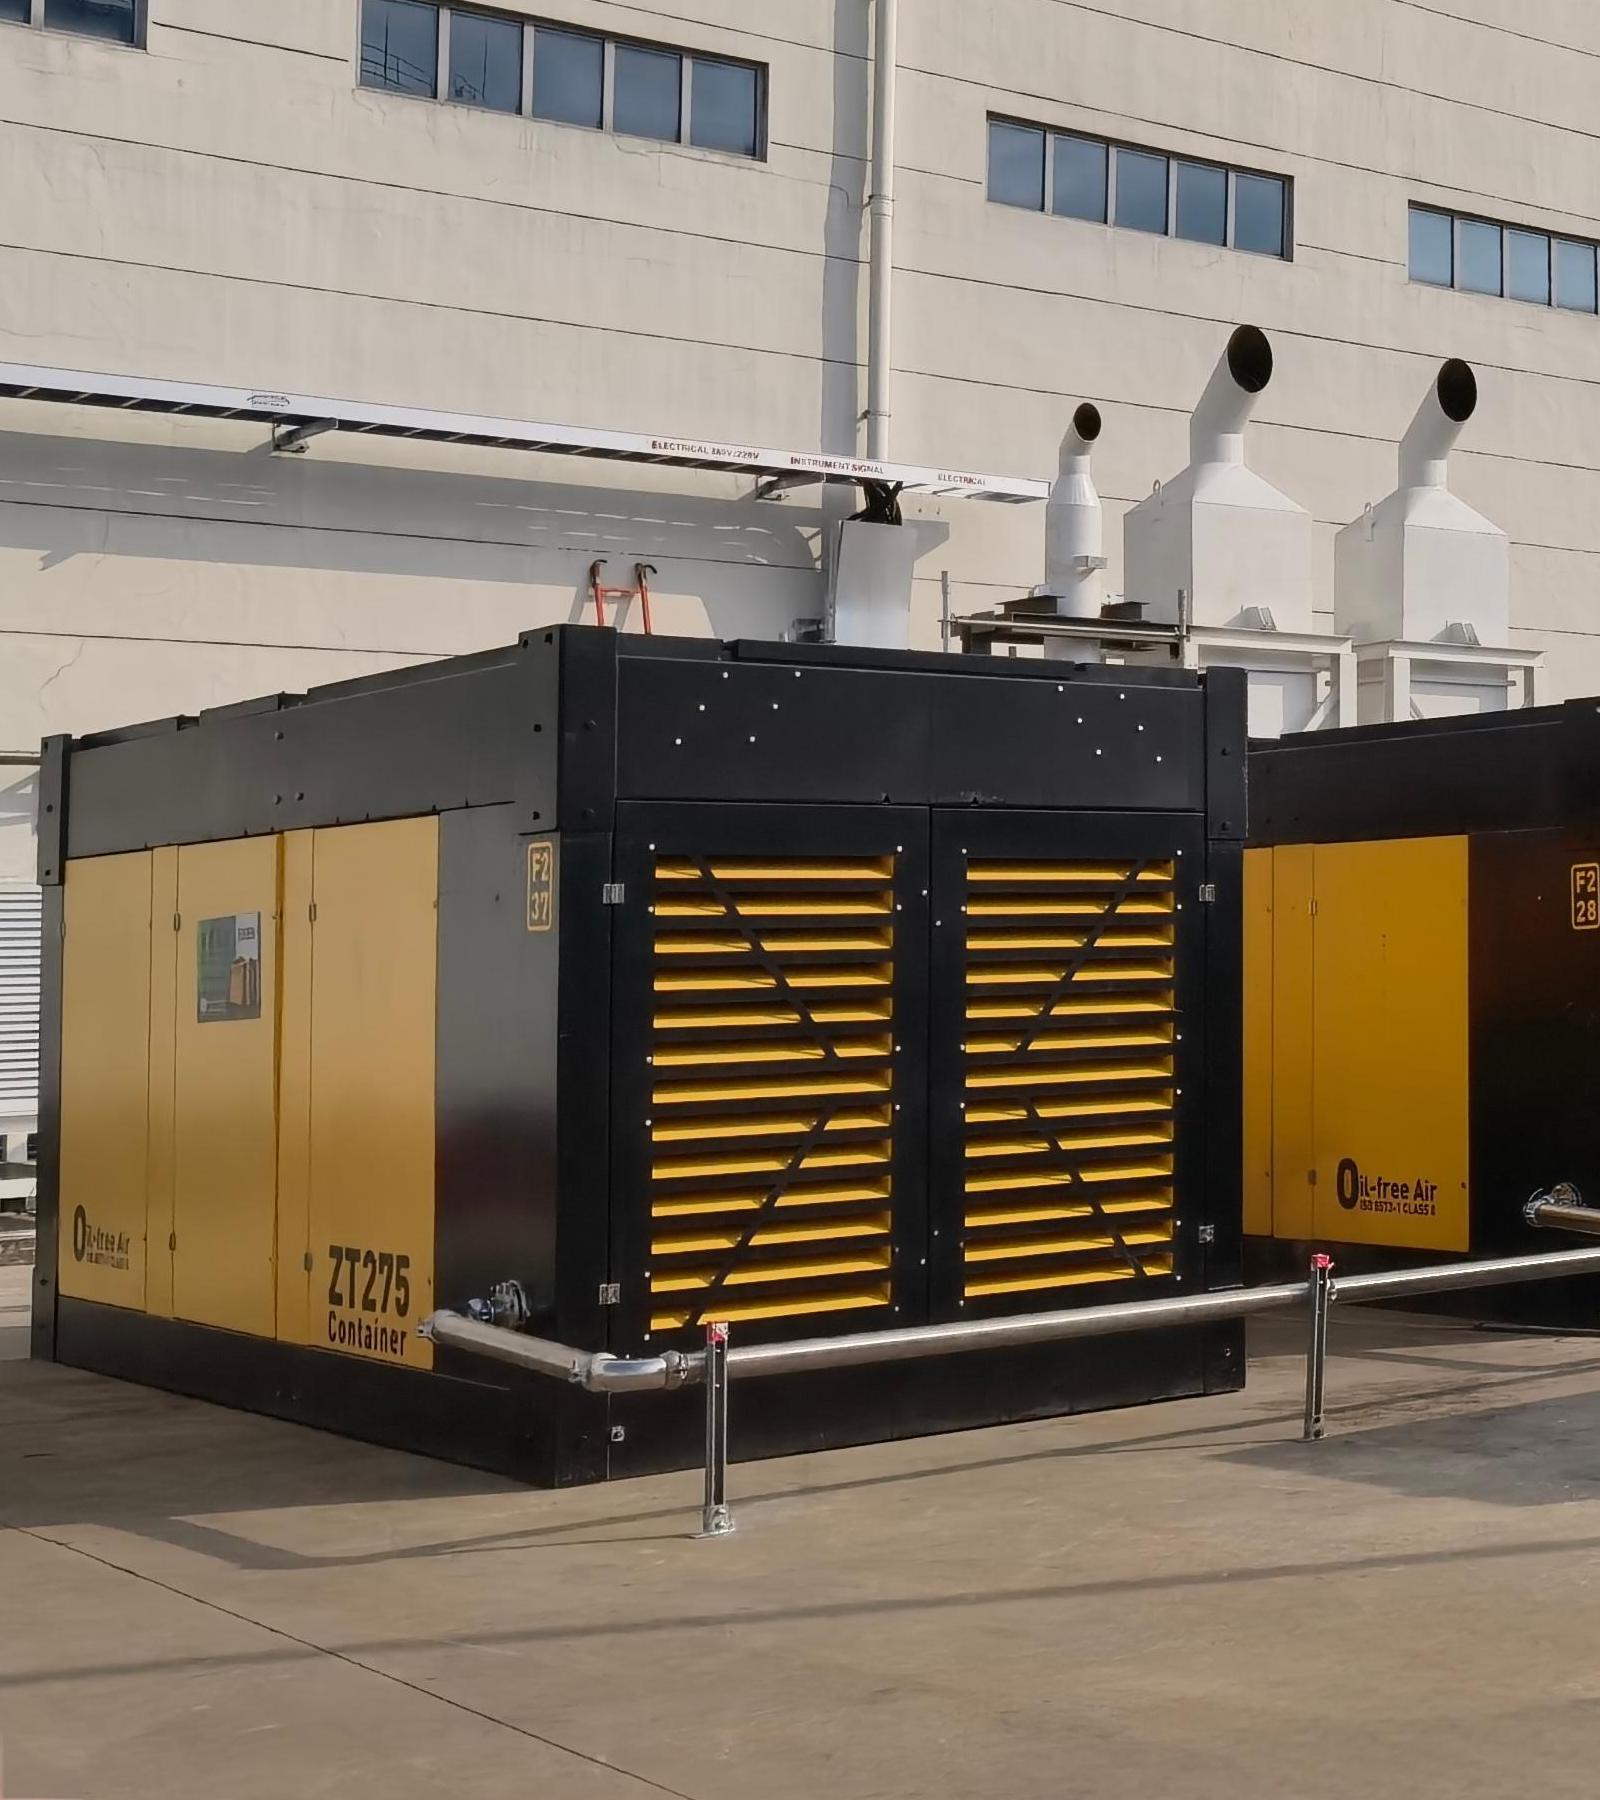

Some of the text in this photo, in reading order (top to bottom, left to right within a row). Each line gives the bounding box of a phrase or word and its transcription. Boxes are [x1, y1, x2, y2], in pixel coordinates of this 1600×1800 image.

[651, 440, 708, 454] ELECTRICAL
[790, 456, 884, 474] INSTRUMENT SIGNAL
[937, 472, 987, 486] ELECTRICAL
[532, 852, 549, 882] F2
[1575, 870, 1597, 893] F2
[1576, 900, 1597, 922] 28
[1337, 1157, 1438, 1210] Oil-free Air
[1402, 1203, 1429, 1216] CLASS
[328, 1244, 410, 1318] ZT275
[328, 1310, 408, 1357] Container
